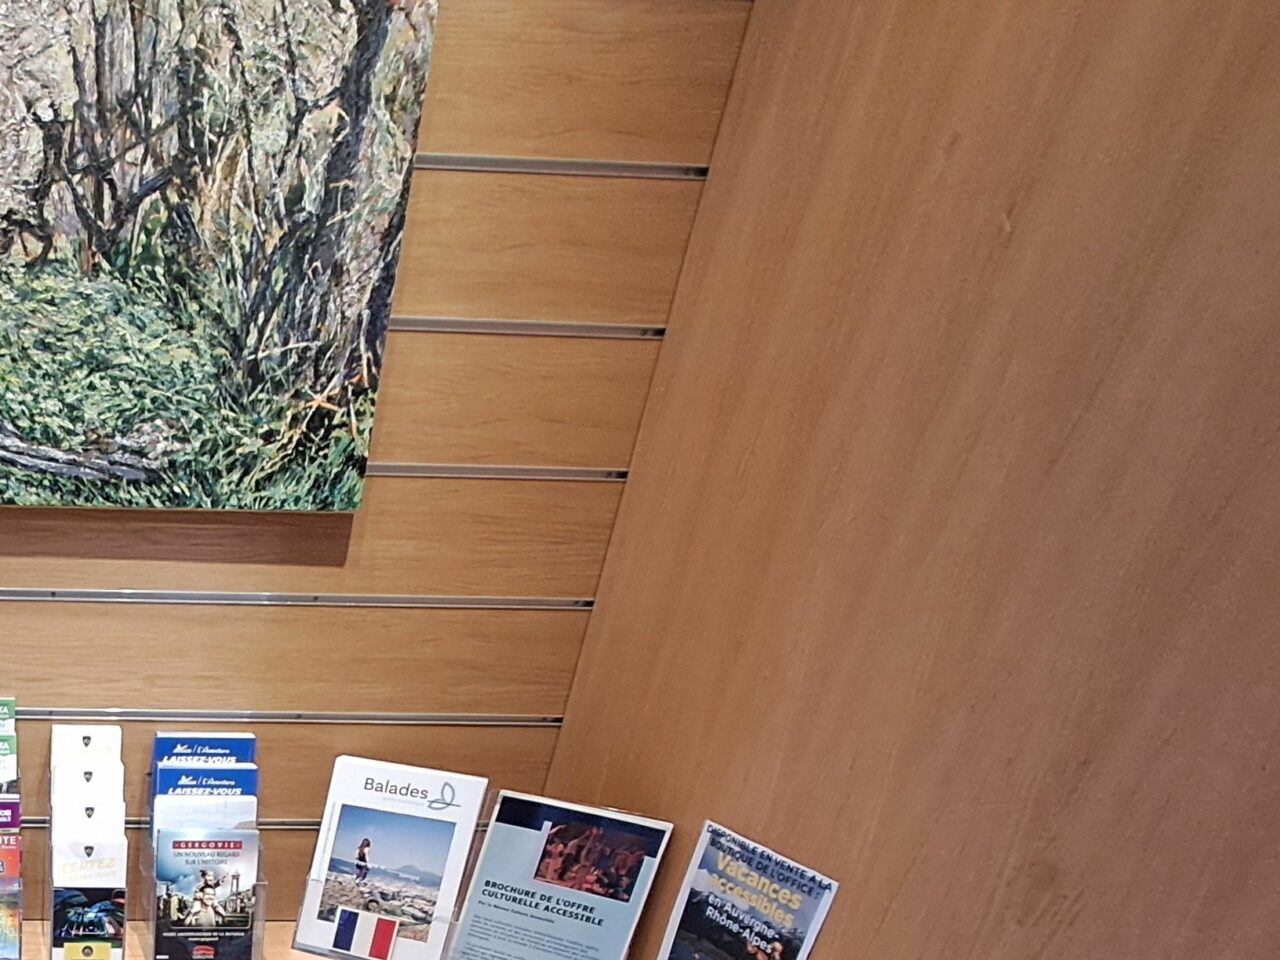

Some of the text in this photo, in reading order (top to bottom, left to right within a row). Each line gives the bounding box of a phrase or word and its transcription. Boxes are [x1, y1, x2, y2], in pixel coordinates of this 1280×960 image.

[161, 755, 237, 764] LAISSEZ-VOUS
[167, 787, 243, 796] LAISSEZ-VOUS
[363, 777, 429, 800] Balades
[179, 841, 235, 849] GERGOVIE
[706, 824, 759, 856] DISPONIBLE
[759, 849, 772, 863] EN
[774, 857, 809, 880] VENTE
[818, 878, 833, 892] LA
[709, 836, 754, 867] BOUTIQUE
[755, 859, 769, 874] DE
[770, 867, 817, 896] L'OFFICE
[483, 879, 596, 915] BROCHURE DE L'OFFRE
[708, 873, 795, 929] accessibles
[717, 852, 803, 910] Vacances
[481, 888, 540, 910] CULTURELLE
[543, 904, 604, 927] ACCESSIBLE
[708, 894, 780, 939] en Auvergne-
[705, 905, 774, 954] Rhône-Alpes
